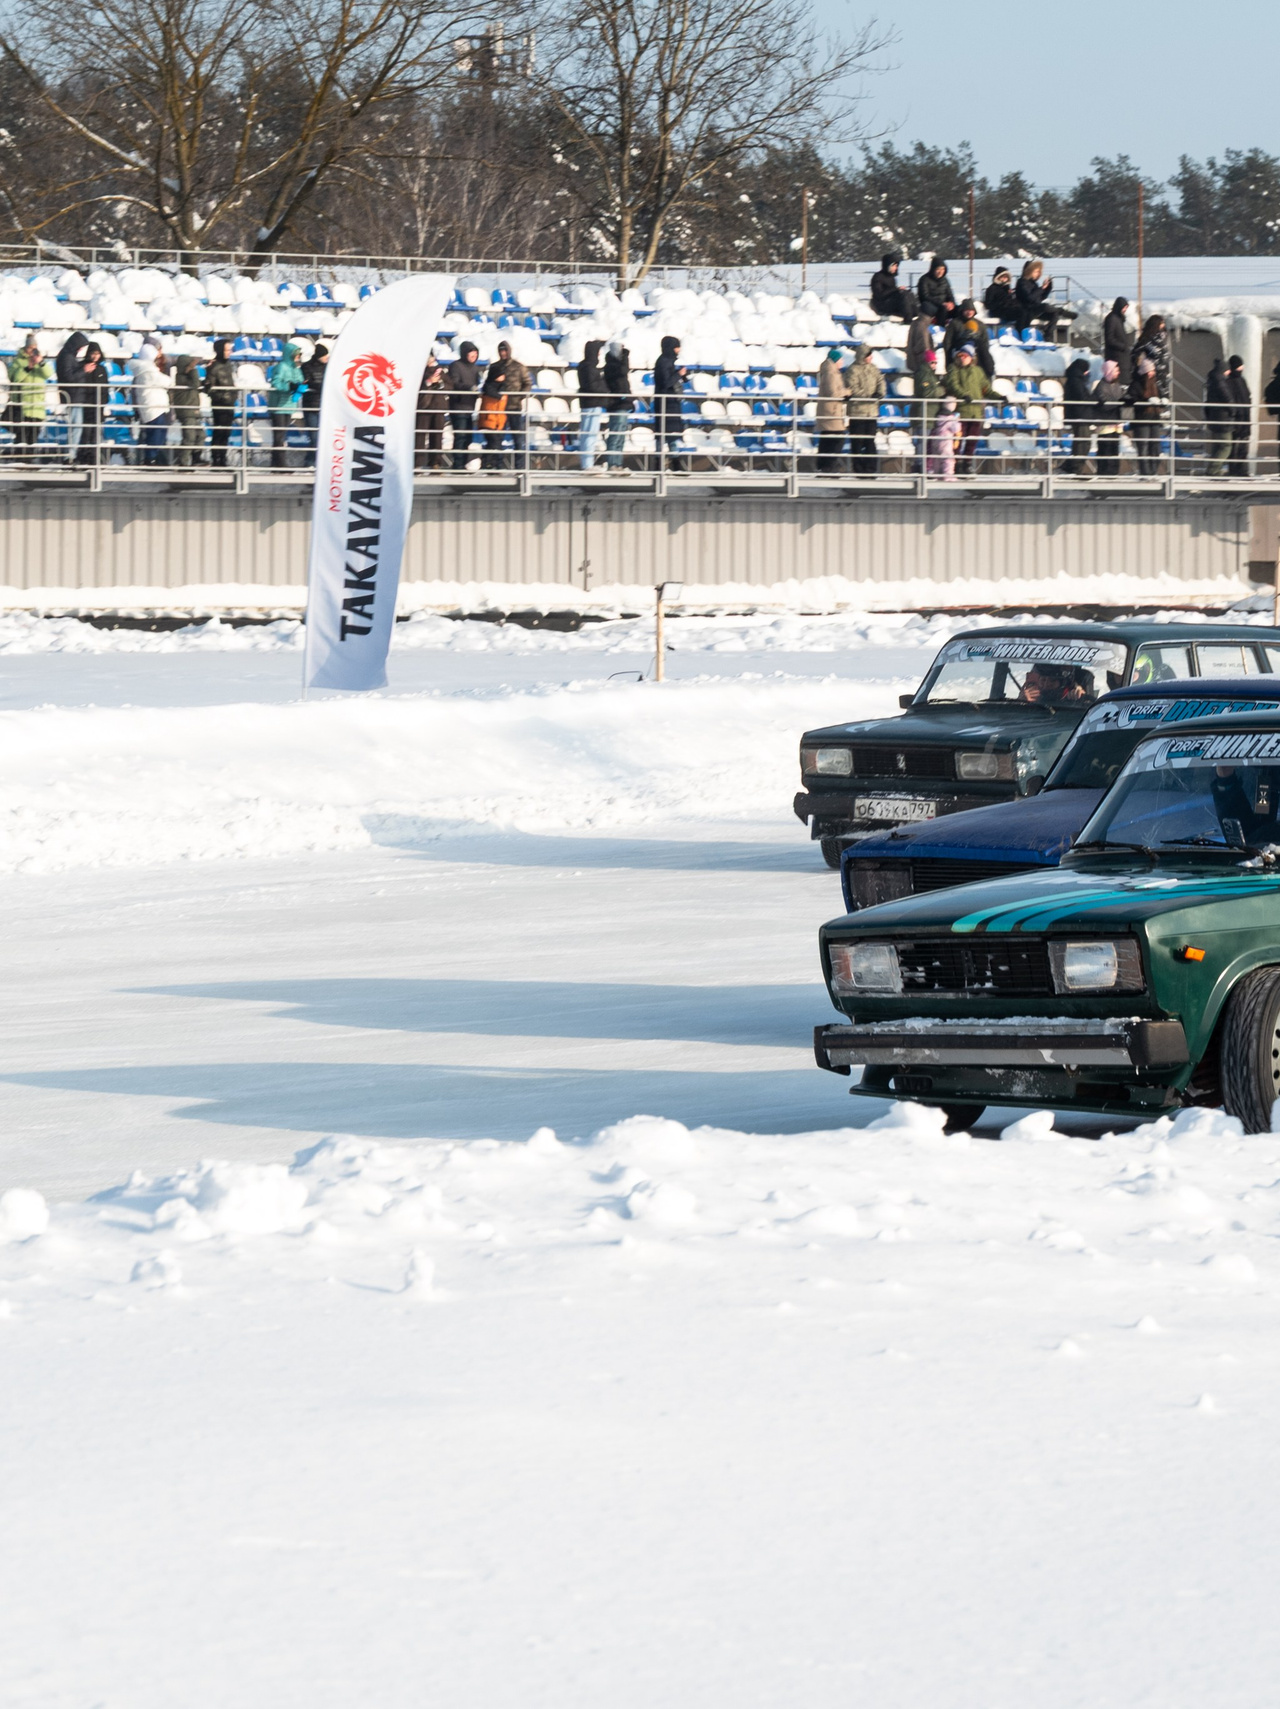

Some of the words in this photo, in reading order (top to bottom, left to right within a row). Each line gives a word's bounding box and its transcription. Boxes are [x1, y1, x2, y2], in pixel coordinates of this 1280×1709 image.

[333, 425, 347, 451] OIL
[329, 455, 345, 513] MOTOR
[340, 426, 386, 642] TAKAYAMA
[969, 645, 995, 653] DRIFT
[992, 644, 1054, 660] WINTER
[1048, 645, 1100, 663] MODE
[1132, 704, 1169, 715] DRIFT
[1161, 700, 1232, 722] DRIFT
[1171, 739, 1212, 752] DRIFT
[910, 802, 931, 815] 797
